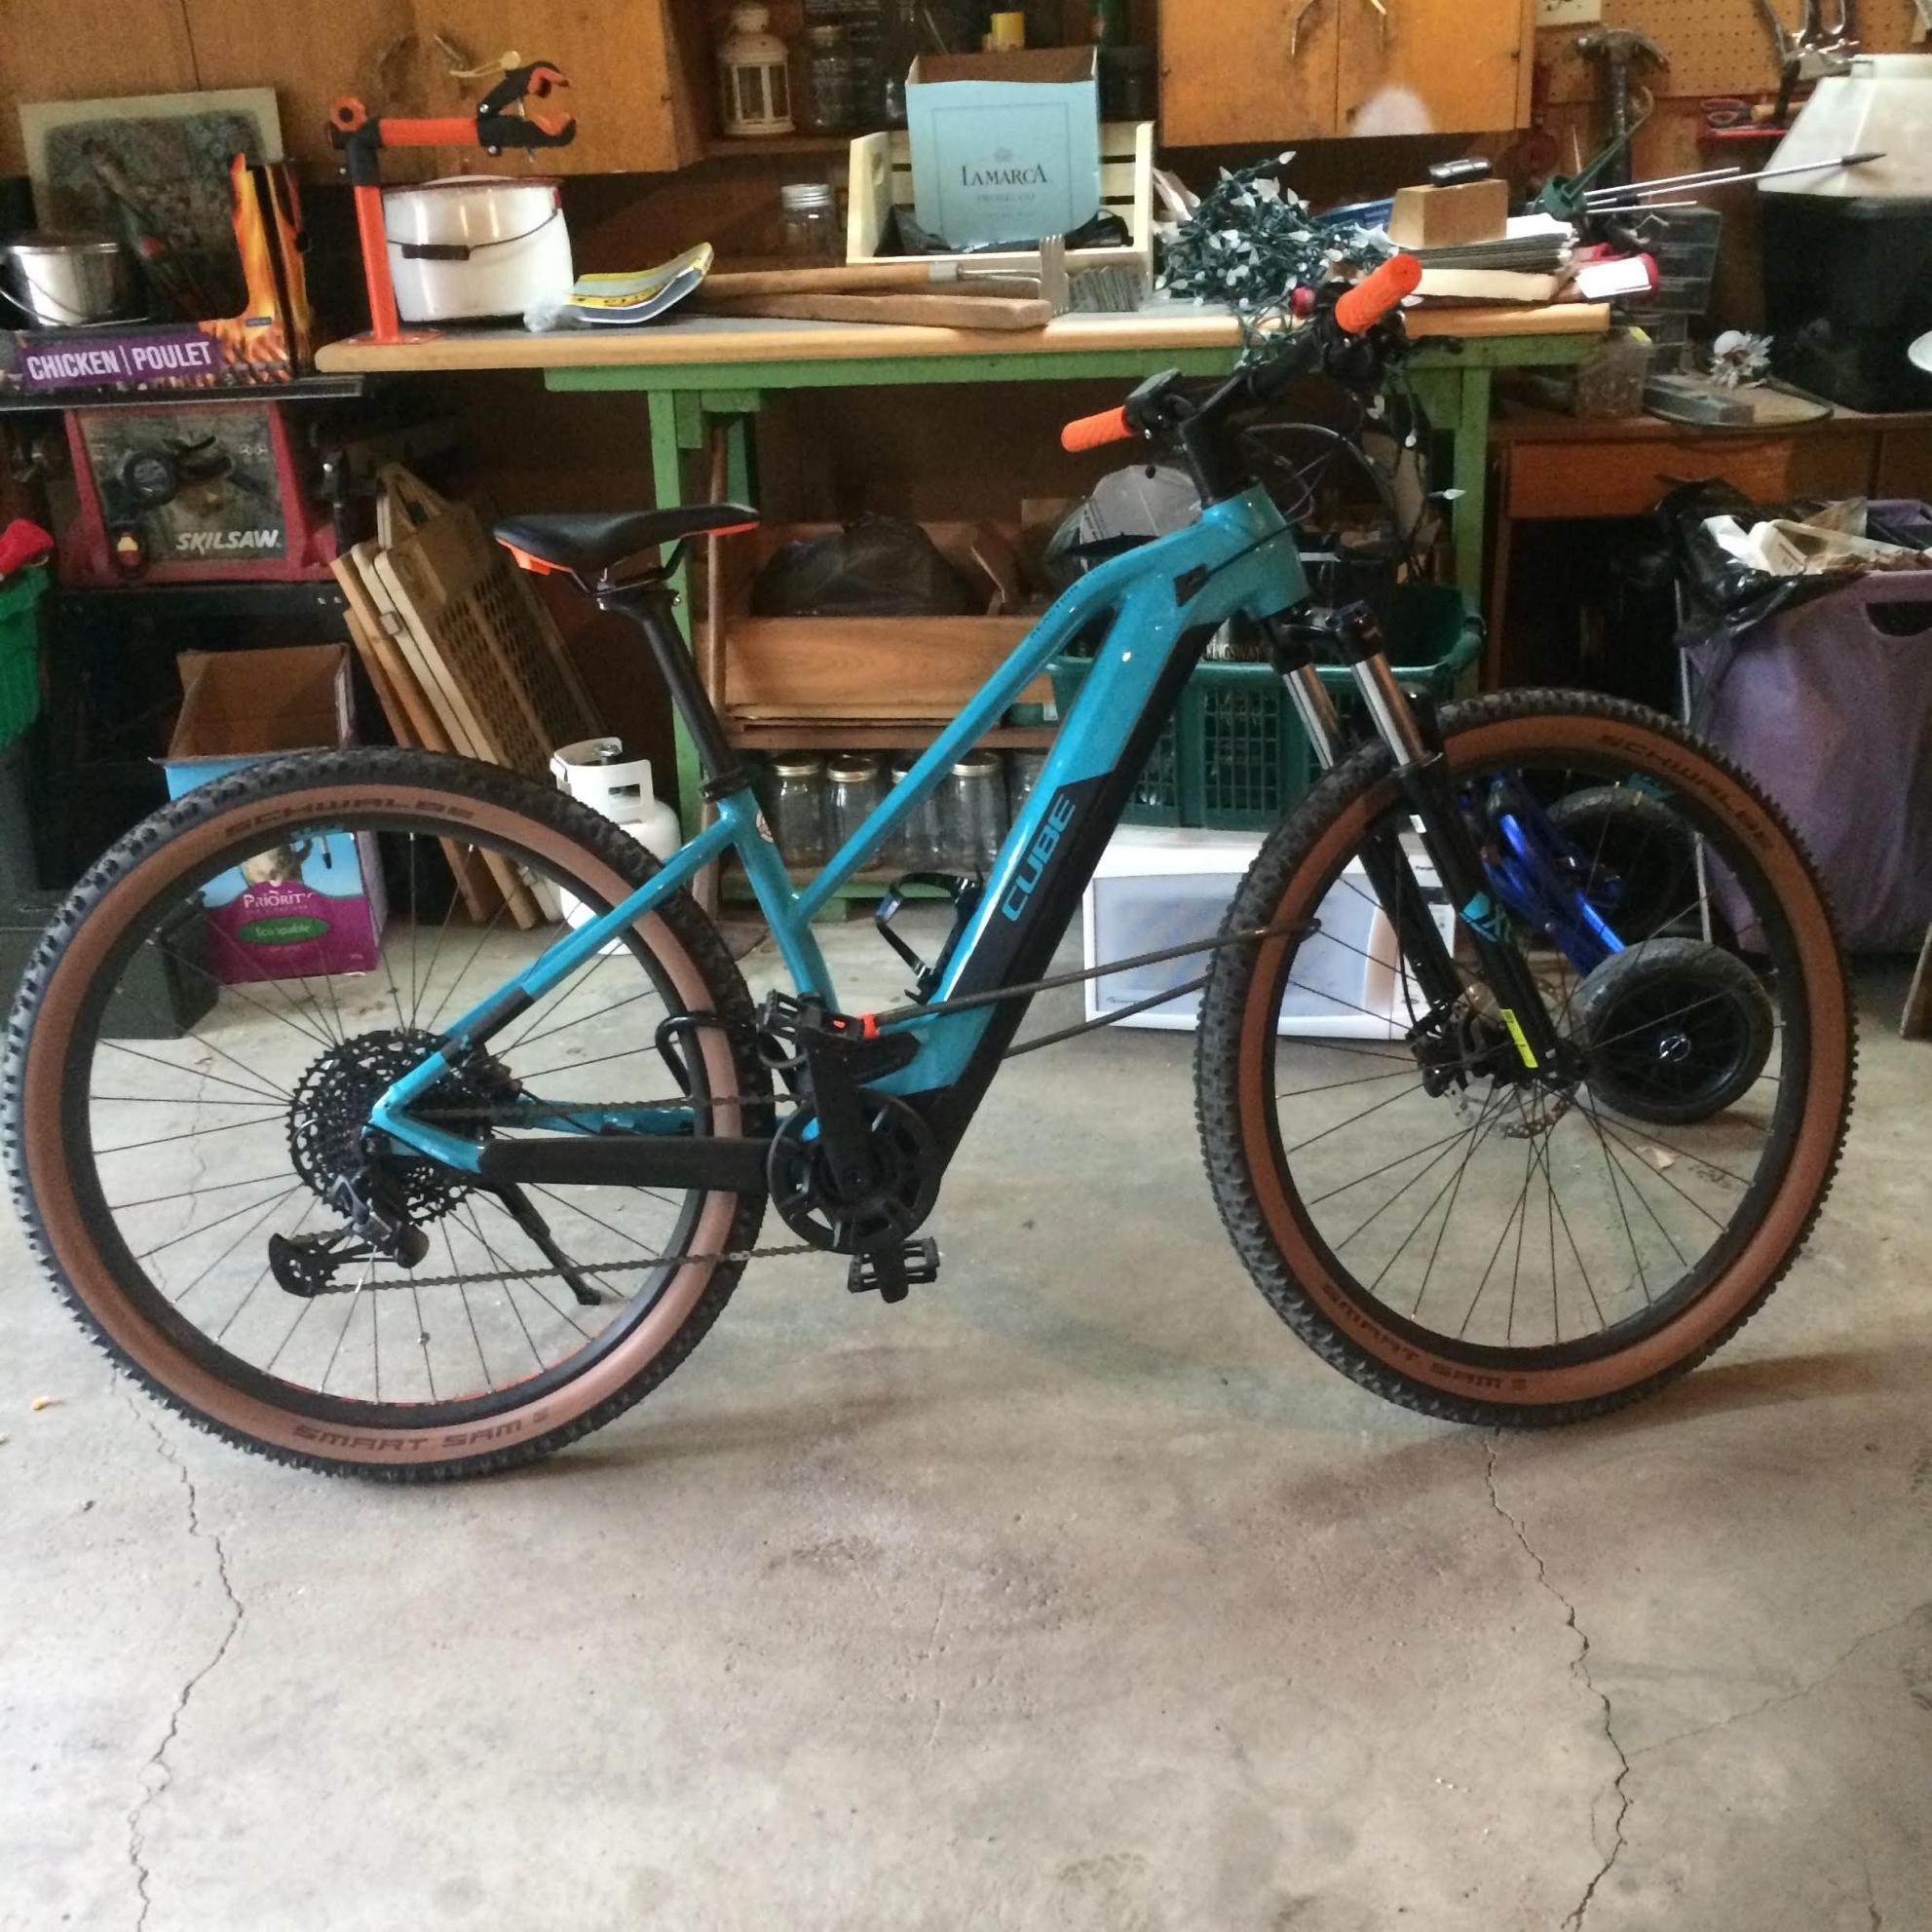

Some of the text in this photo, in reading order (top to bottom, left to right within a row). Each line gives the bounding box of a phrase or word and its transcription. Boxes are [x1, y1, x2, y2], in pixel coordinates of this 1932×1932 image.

[26, 341, 210, 381] CHICKEN POULET
[175, 528, 280, 554] SKILSAW
[1002, 793, 1076, 921] CUBE
[293, 1419, 522, 1452] SMART SAM
